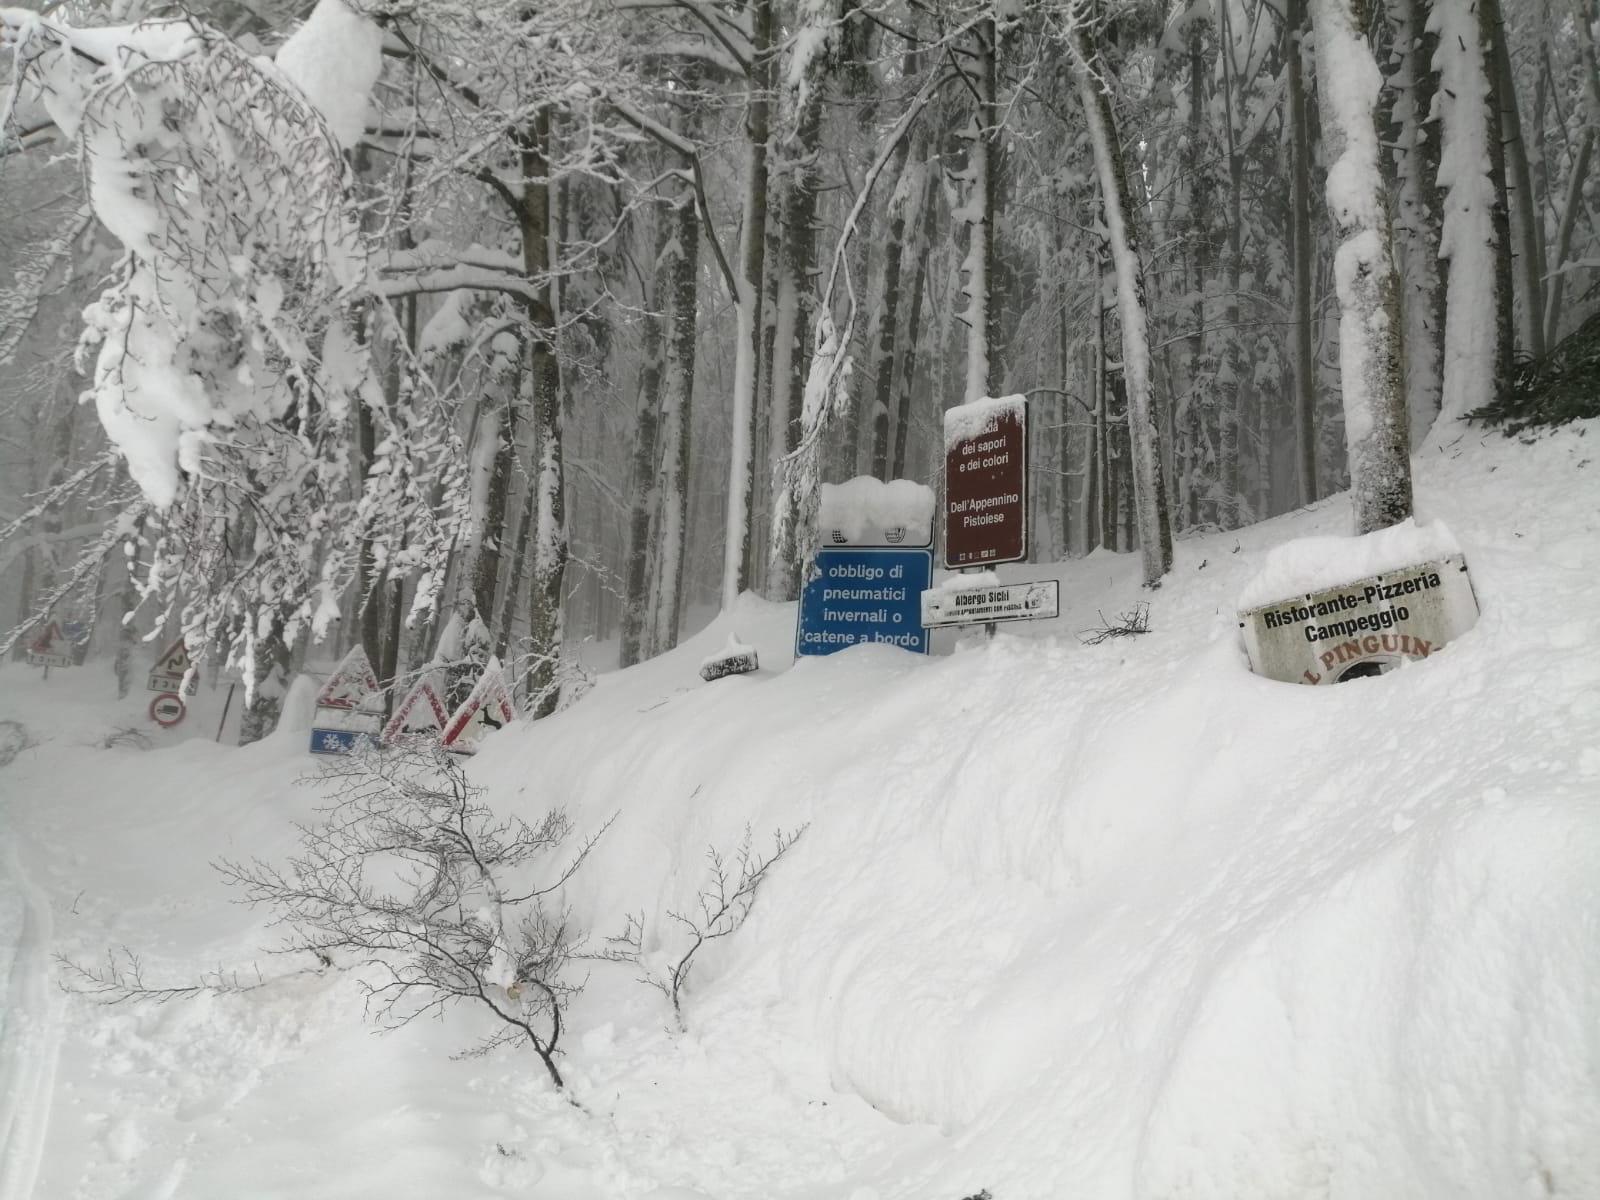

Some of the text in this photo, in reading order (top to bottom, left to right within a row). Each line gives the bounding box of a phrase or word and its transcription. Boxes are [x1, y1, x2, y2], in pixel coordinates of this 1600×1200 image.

[962, 435, 1006, 455] dei sapori
[960, 451, 1009, 472] e dei colori
[963, 513, 1004, 528] Pistoiese
[829, 564, 903, 580] obbligo di
[823, 587, 906, 601] pneumatici
[955, 594, 986, 607] Albergo
[1264, 572, 1441, 629] Ristorante-Pizzeria
[823, 608, 902, 623] invernali o
[1305, 605, 1410, 642] Campeggio
[804, 630, 919, 646] catene a bordo
[1319, 634, 1442, 671] PINGUIN
